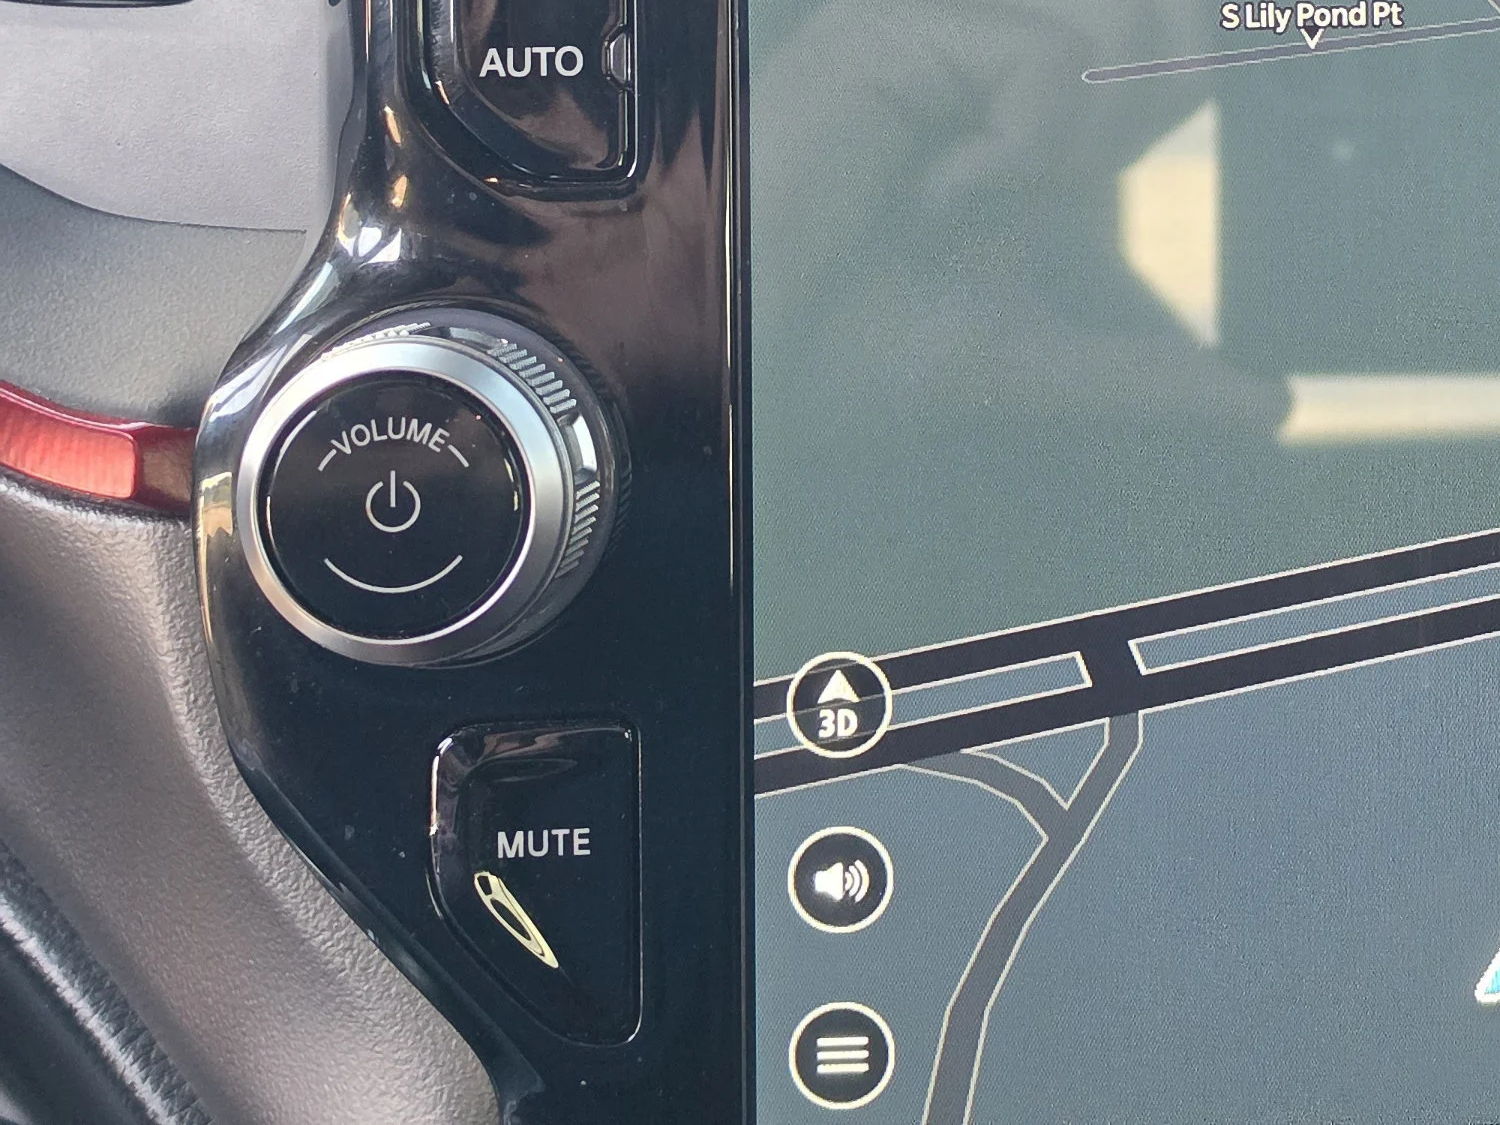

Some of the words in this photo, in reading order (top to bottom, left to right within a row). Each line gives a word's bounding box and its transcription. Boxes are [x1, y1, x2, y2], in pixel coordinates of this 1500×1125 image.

[1220, 3, 1241, 29] S
[1244, 2, 1292, 33] Lily
[1297, 1, 1368, 27] Pond
[1372, 1, 1404, 26] Pt
[479, 46, 584, 78] AUTO
[331, 417, 452, 456] VOLUME
[818, 708, 858, 738] 3D
[496, 827, 591, 859] MUTE
